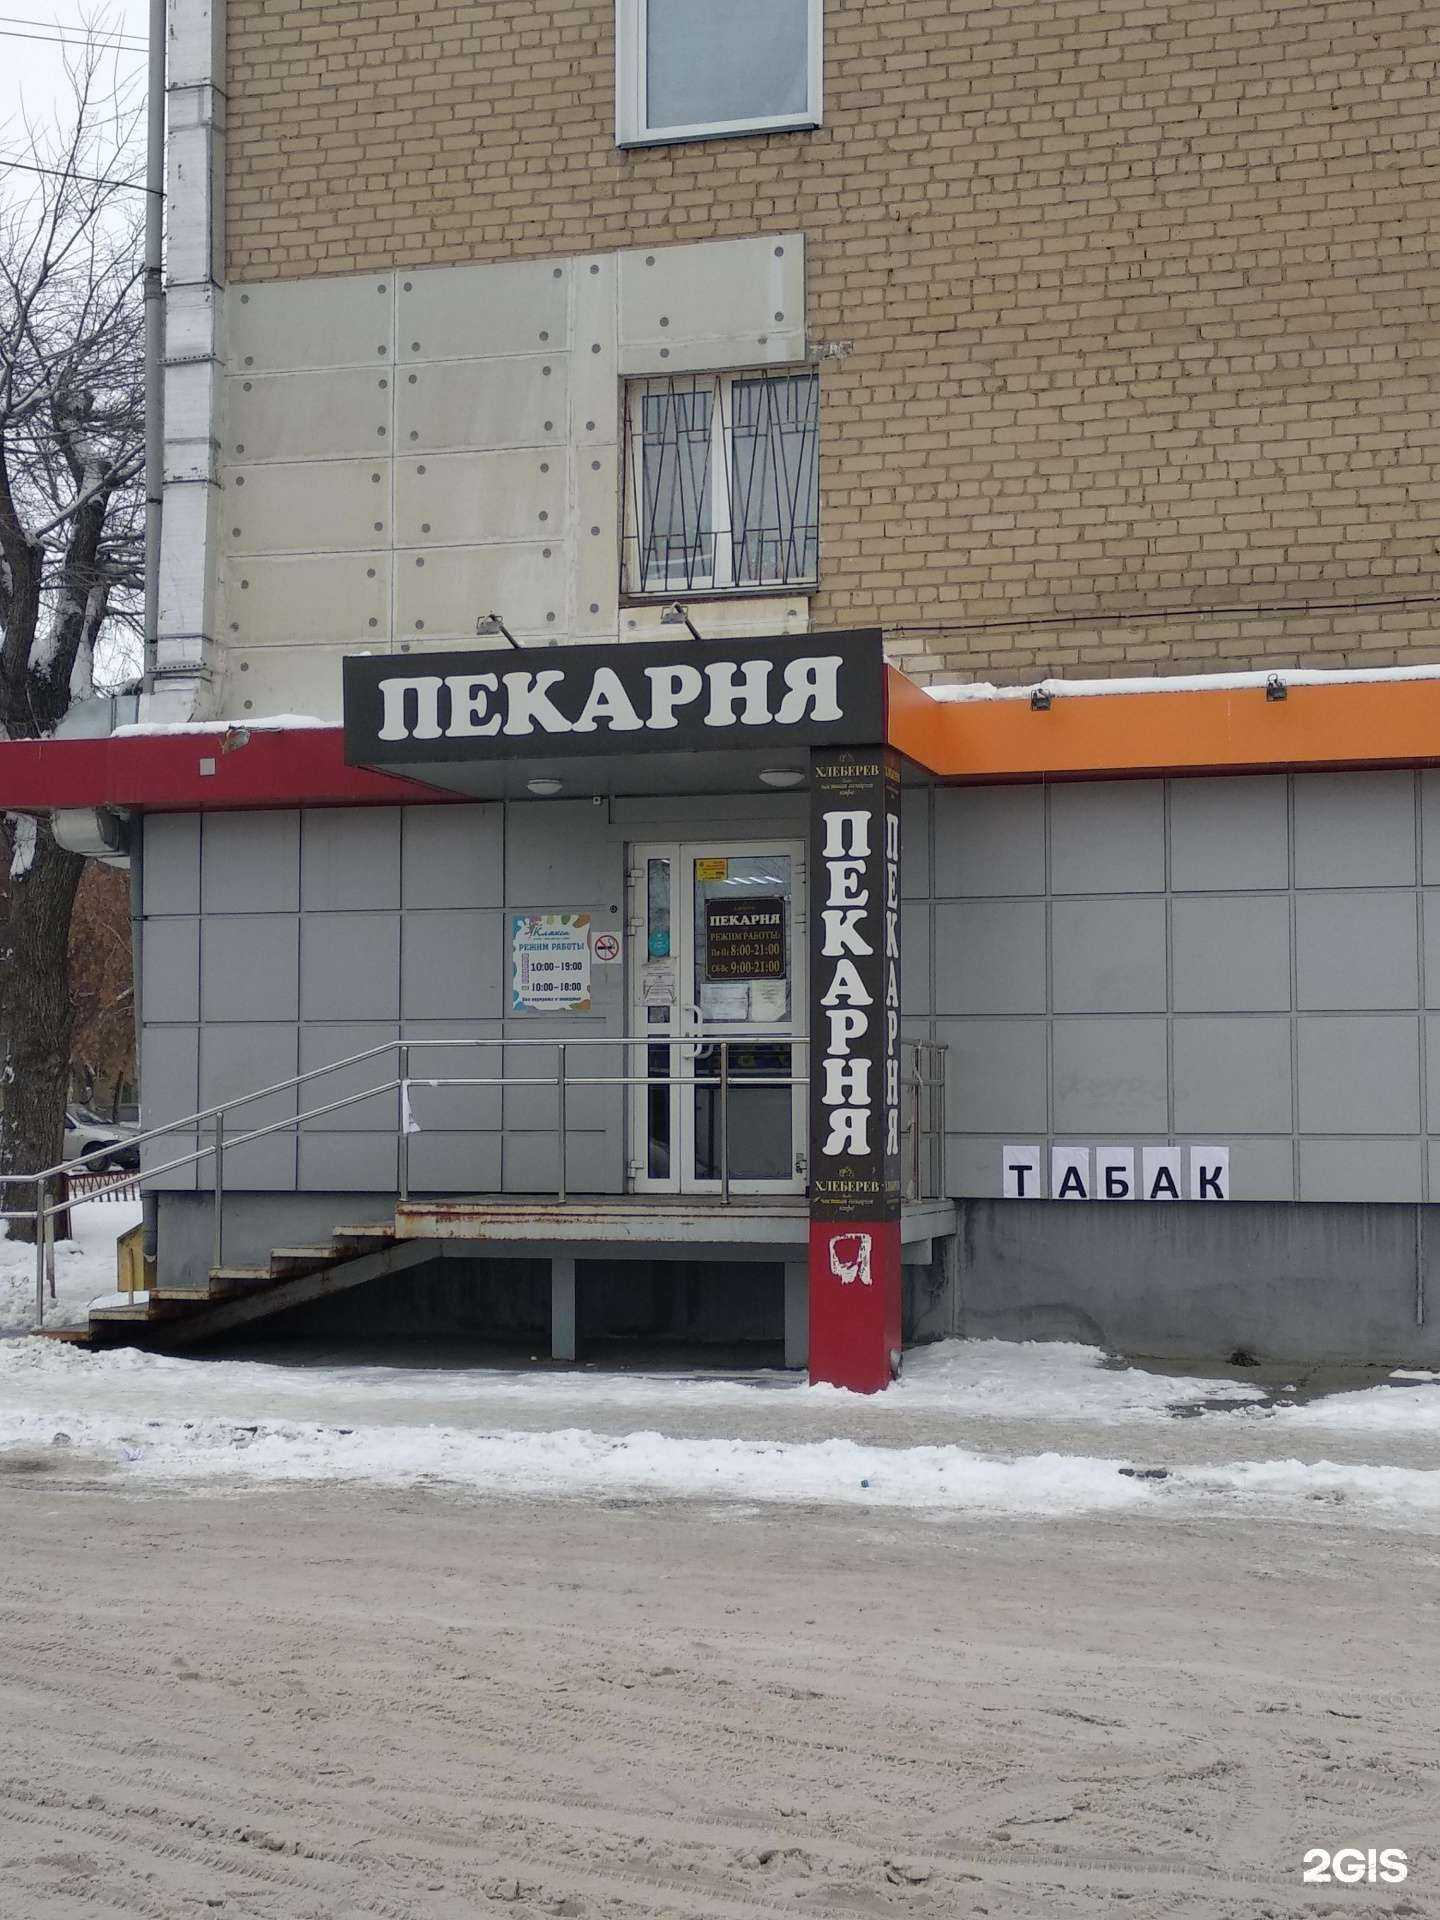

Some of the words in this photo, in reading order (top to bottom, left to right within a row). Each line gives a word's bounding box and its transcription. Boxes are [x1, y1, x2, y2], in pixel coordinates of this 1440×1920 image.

[378, 656, 843, 741] ПЕКАРНЯ
[815, 764, 880, 778] ХЛЕБЕРЕВ
[710, 914, 780, 926] ПЕКАРНЯ
[710, 932, 742, 941] РЕЖИМ
[520, 943, 548, 951] РЕЖИМ
[730, 943, 780, 956] 8:00-21:00
[730, 960, 780, 973] 9:00-21:00
[820, 810, 874, 1156] ПЕКАРНЯ
[886, 812, 899, 1156] ПЕКАРНЯ
[815, 1180, 880, 1193] ХЛЕБЕРЕВ
[1008, 1164, 1225, 1199] ТАБАК
